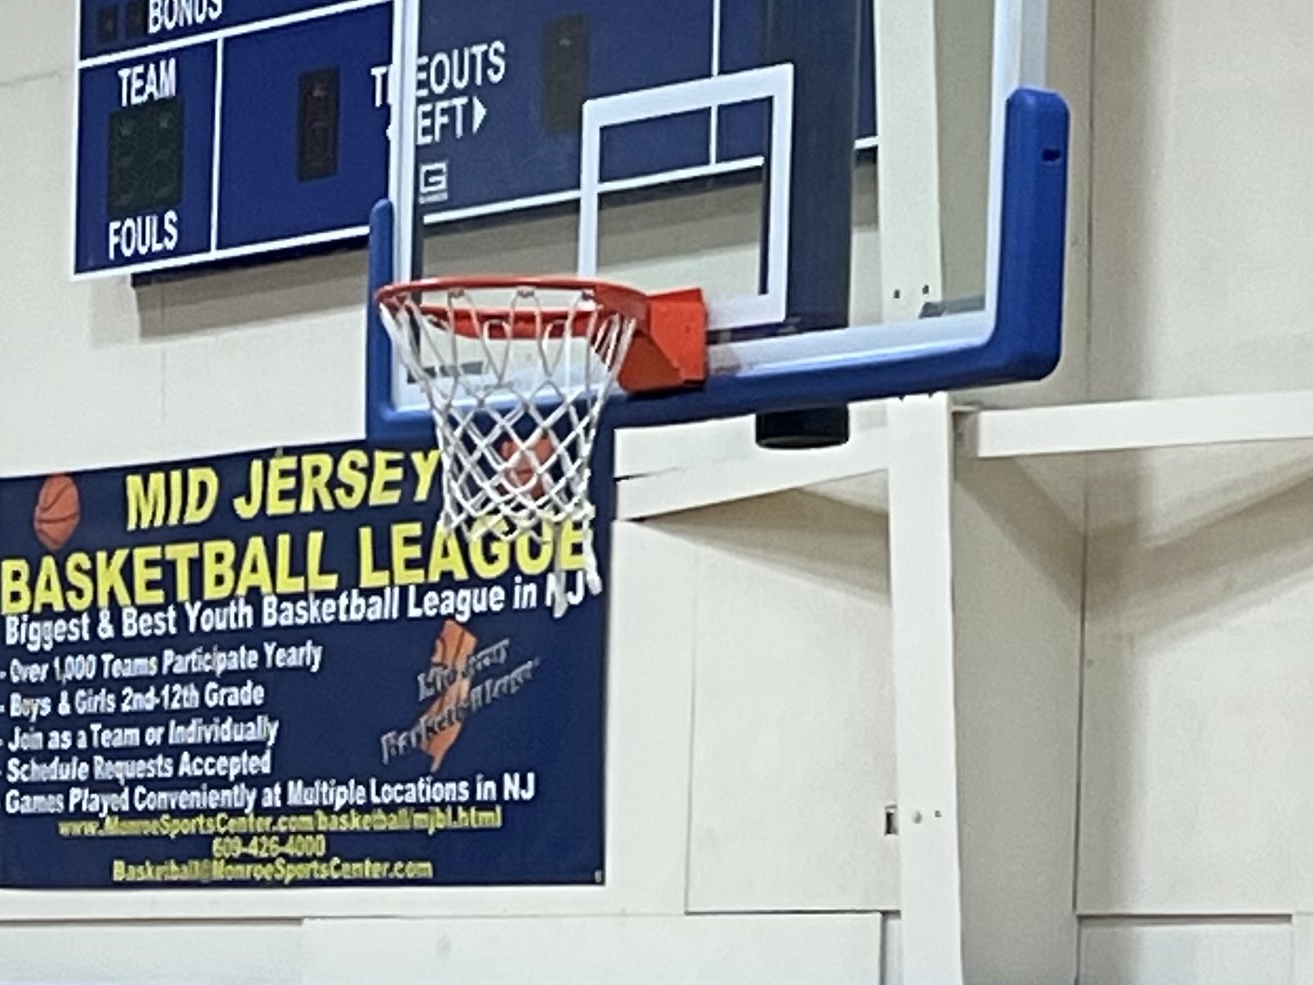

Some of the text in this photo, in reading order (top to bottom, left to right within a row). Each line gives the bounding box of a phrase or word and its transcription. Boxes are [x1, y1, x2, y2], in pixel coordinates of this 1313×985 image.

[148, 0, 222, 33] BONUS
[118, 59, 176, 106] TEAM
[371, 41, 505, 108] TEOUTS
[417, 97, 469, 145] EFT
[108, 211, 178, 259] FOULS
[126, 449, 440, 531] MID JERSEY
[1, 511, 587, 616] BASKETBALL LEAGUE
[5, 613, 90, 652] Biggest
[97, 609, 115, 639] &
[121, 605, 178, 639] Best
[187, 597, 254, 632] Youth
[262, 586, 398, 626] Basketball
[407, 584, 505, 623] League
[513, 575, 537, 609] in
[10, 640, 323, 684] Over 1,000 Teams Participate Yearly
[9, 680, 265, 722] Boys & Girls 2nd-12th Grade
[8, 714, 280, 752] Join as a Team or Individually
[6, 748, 271, 785] Schedule Requests Accepted
[5, 771, 536, 817] Games Played Conveniently at Multiple Locations in NJ
